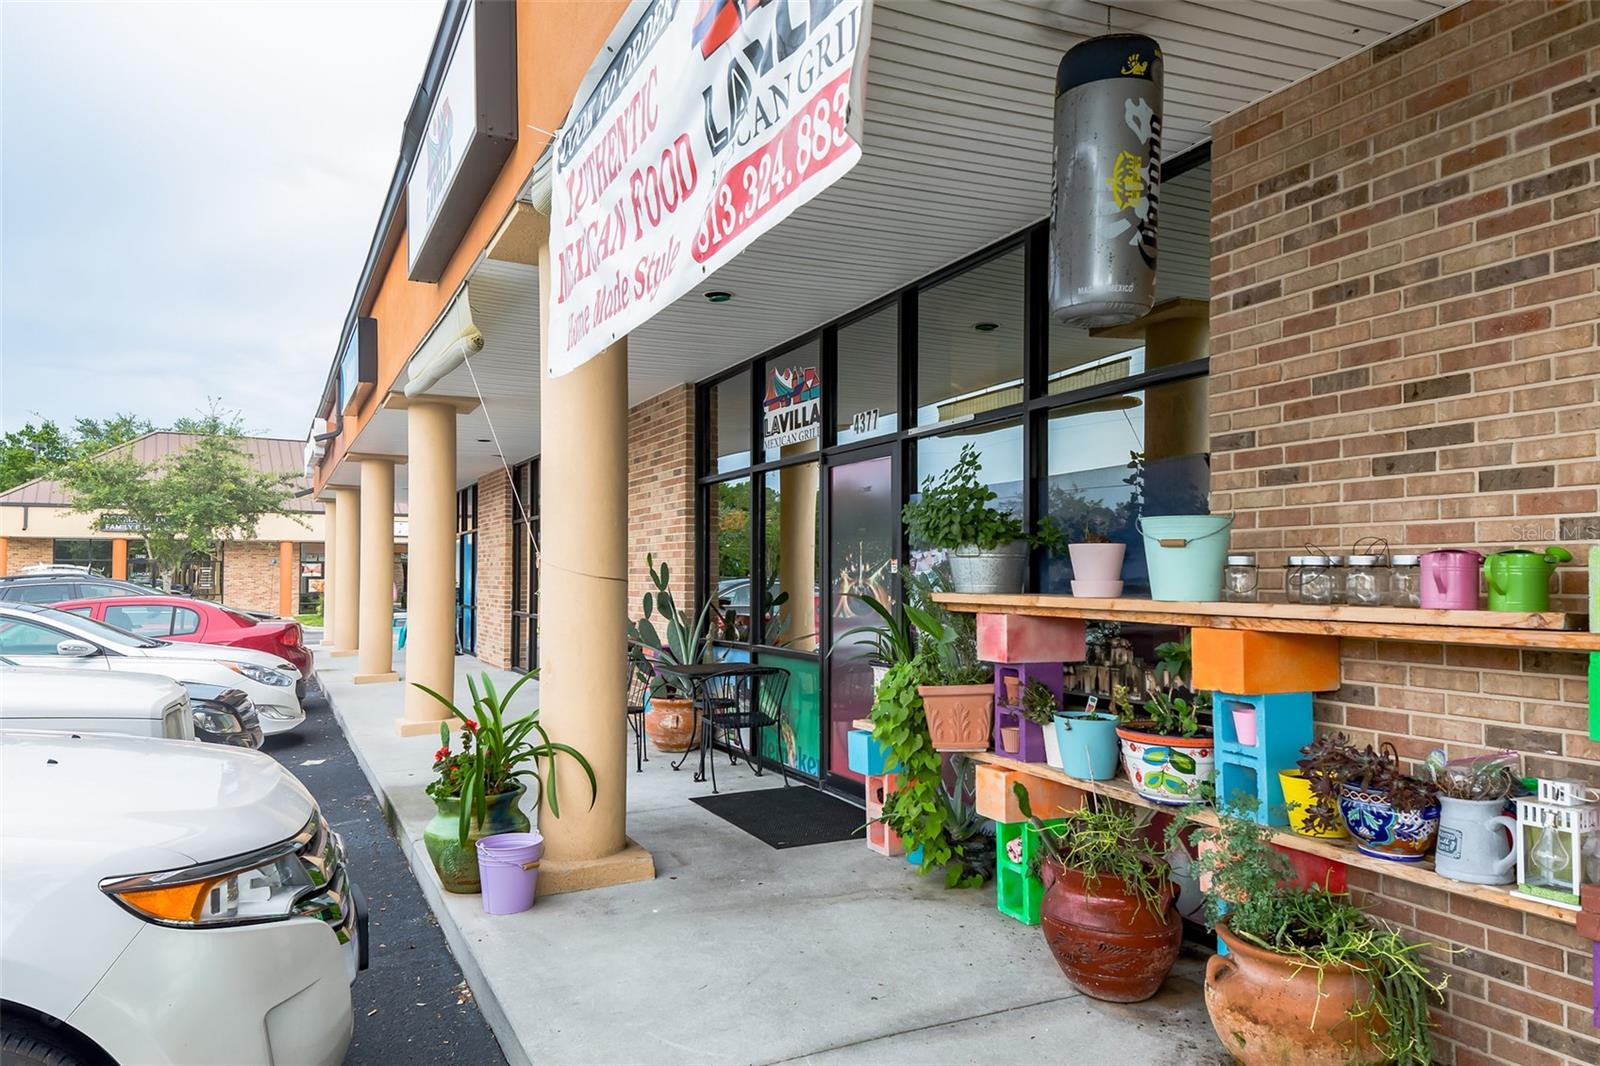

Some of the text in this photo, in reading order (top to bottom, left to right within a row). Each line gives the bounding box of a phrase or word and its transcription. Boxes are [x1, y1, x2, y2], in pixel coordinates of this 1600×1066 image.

[629, 133, 698, 241] FOOD
[593, 269, 629, 329] Made
[633, 235, 681, 302] Style
[764, 402, 820, 437] LAVILLA
[853, 409, 878, 435] 4377
